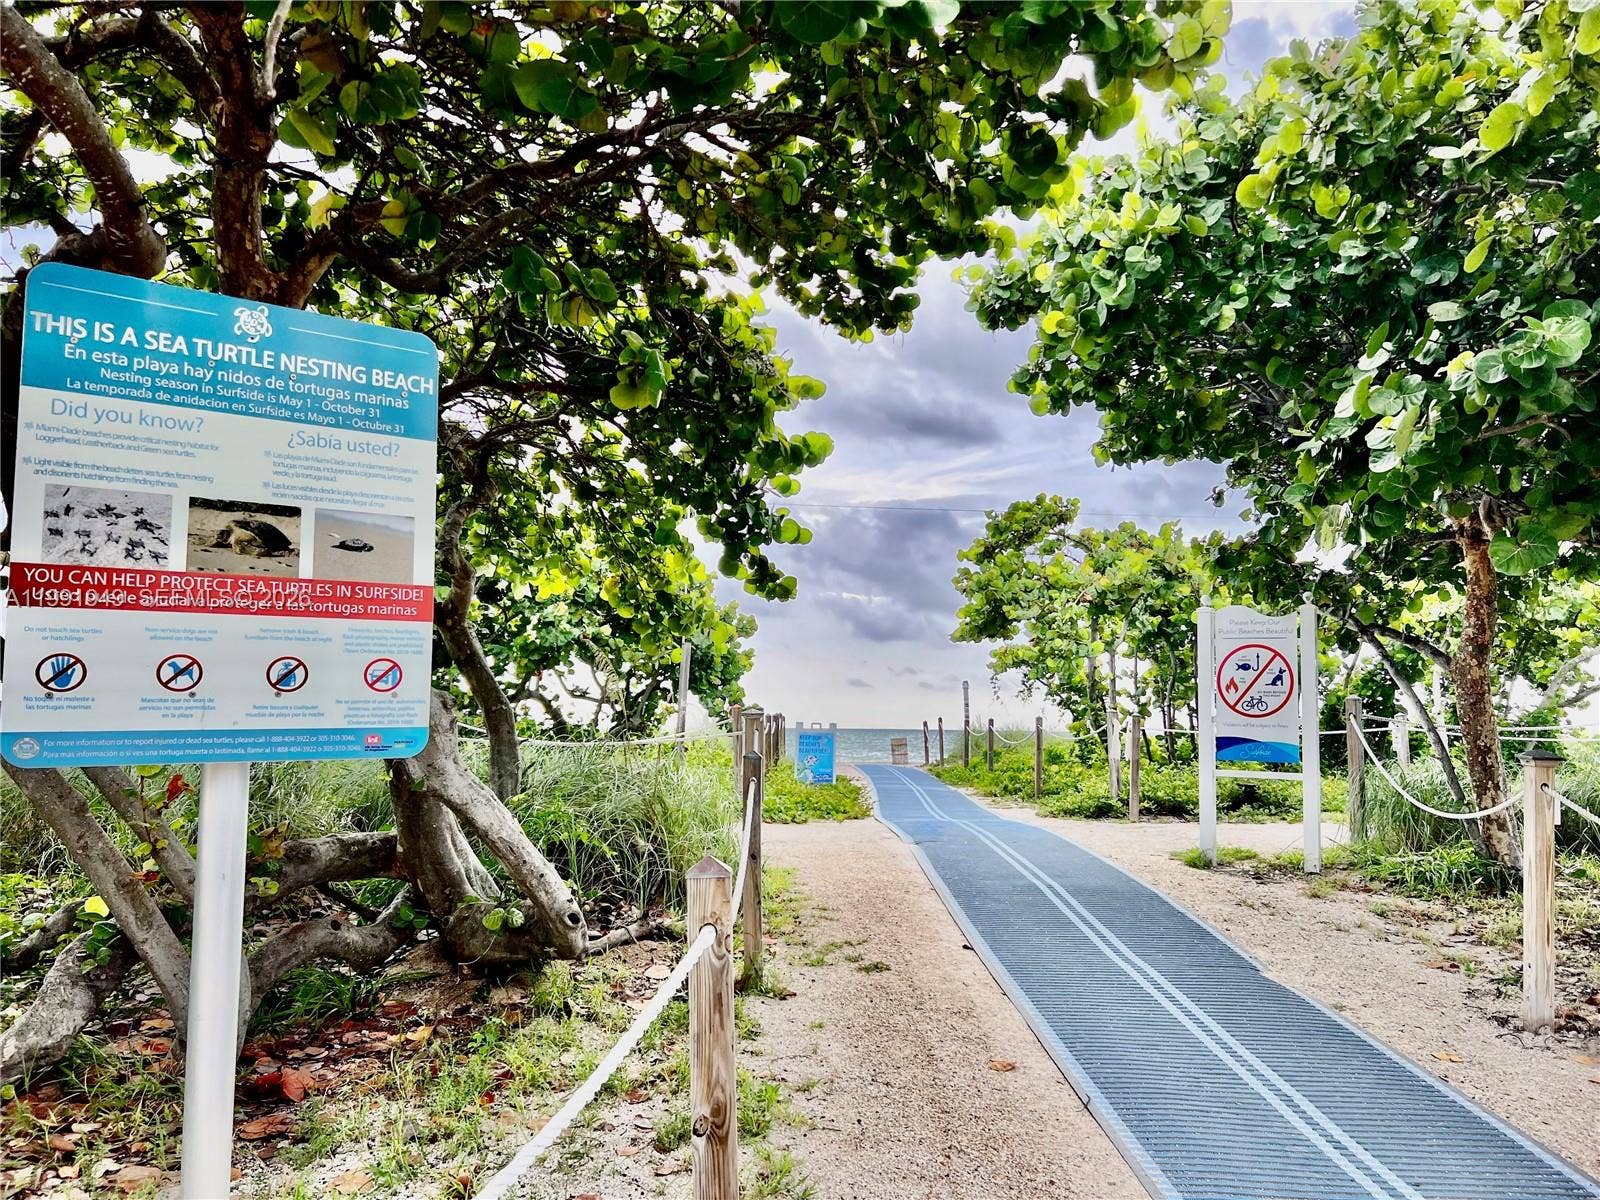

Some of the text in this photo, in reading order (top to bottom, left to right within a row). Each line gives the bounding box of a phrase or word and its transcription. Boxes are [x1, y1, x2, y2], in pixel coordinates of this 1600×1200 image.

[30, 310, 434, 396] THIS IS A SEA TURTLE NESTING BEACH
[64, 343, 410, 409] En esta playa hay nidos de tortugas marinas
[100, 368, 151, 386] Nesting
[155, 376, 198, 392] season
[202, 383, 214, 394] in
[216, 384, 264, 401] Surfside
[268, 393, 276, 402] is
[278, 394, 304, 408] May
[306, 398, 311, 408] 1
[322, 402, 366, 416] October
[368, 408, 380, 418] 31
[51, 398, 204, 433] Did you know?
[66, 378, 81, 390] La
[84, 380, 152, 398] temporada
[155, 390, 171, 402] de
[232, 402, 246, 412] en
[248, 404, 291, 418] Surfside
[294, 410, 306, 420] es
[308, 412, 336, 424] Mayo
[338, 416, 344, 424] 1
[352, 419, 392, 432] Octubre
[394, 424, 405, 433] 31
[288, 430, 400, 457] ¿Sabía usted?
[24, 568, 424, 602] YOU CAN HELP PROTECT SEA TURTLES IN SURFSIDE!
[32, 587, 81, 602] Usted
[86, 590, 137, 606] puede
[210, 598, 272, 612] proteger
[275, 602, 283, 610] a
[287, 598, 305, 612] las
[309, 602, 364, 616] tortugas
[367, 603, 417, 616] marinas
